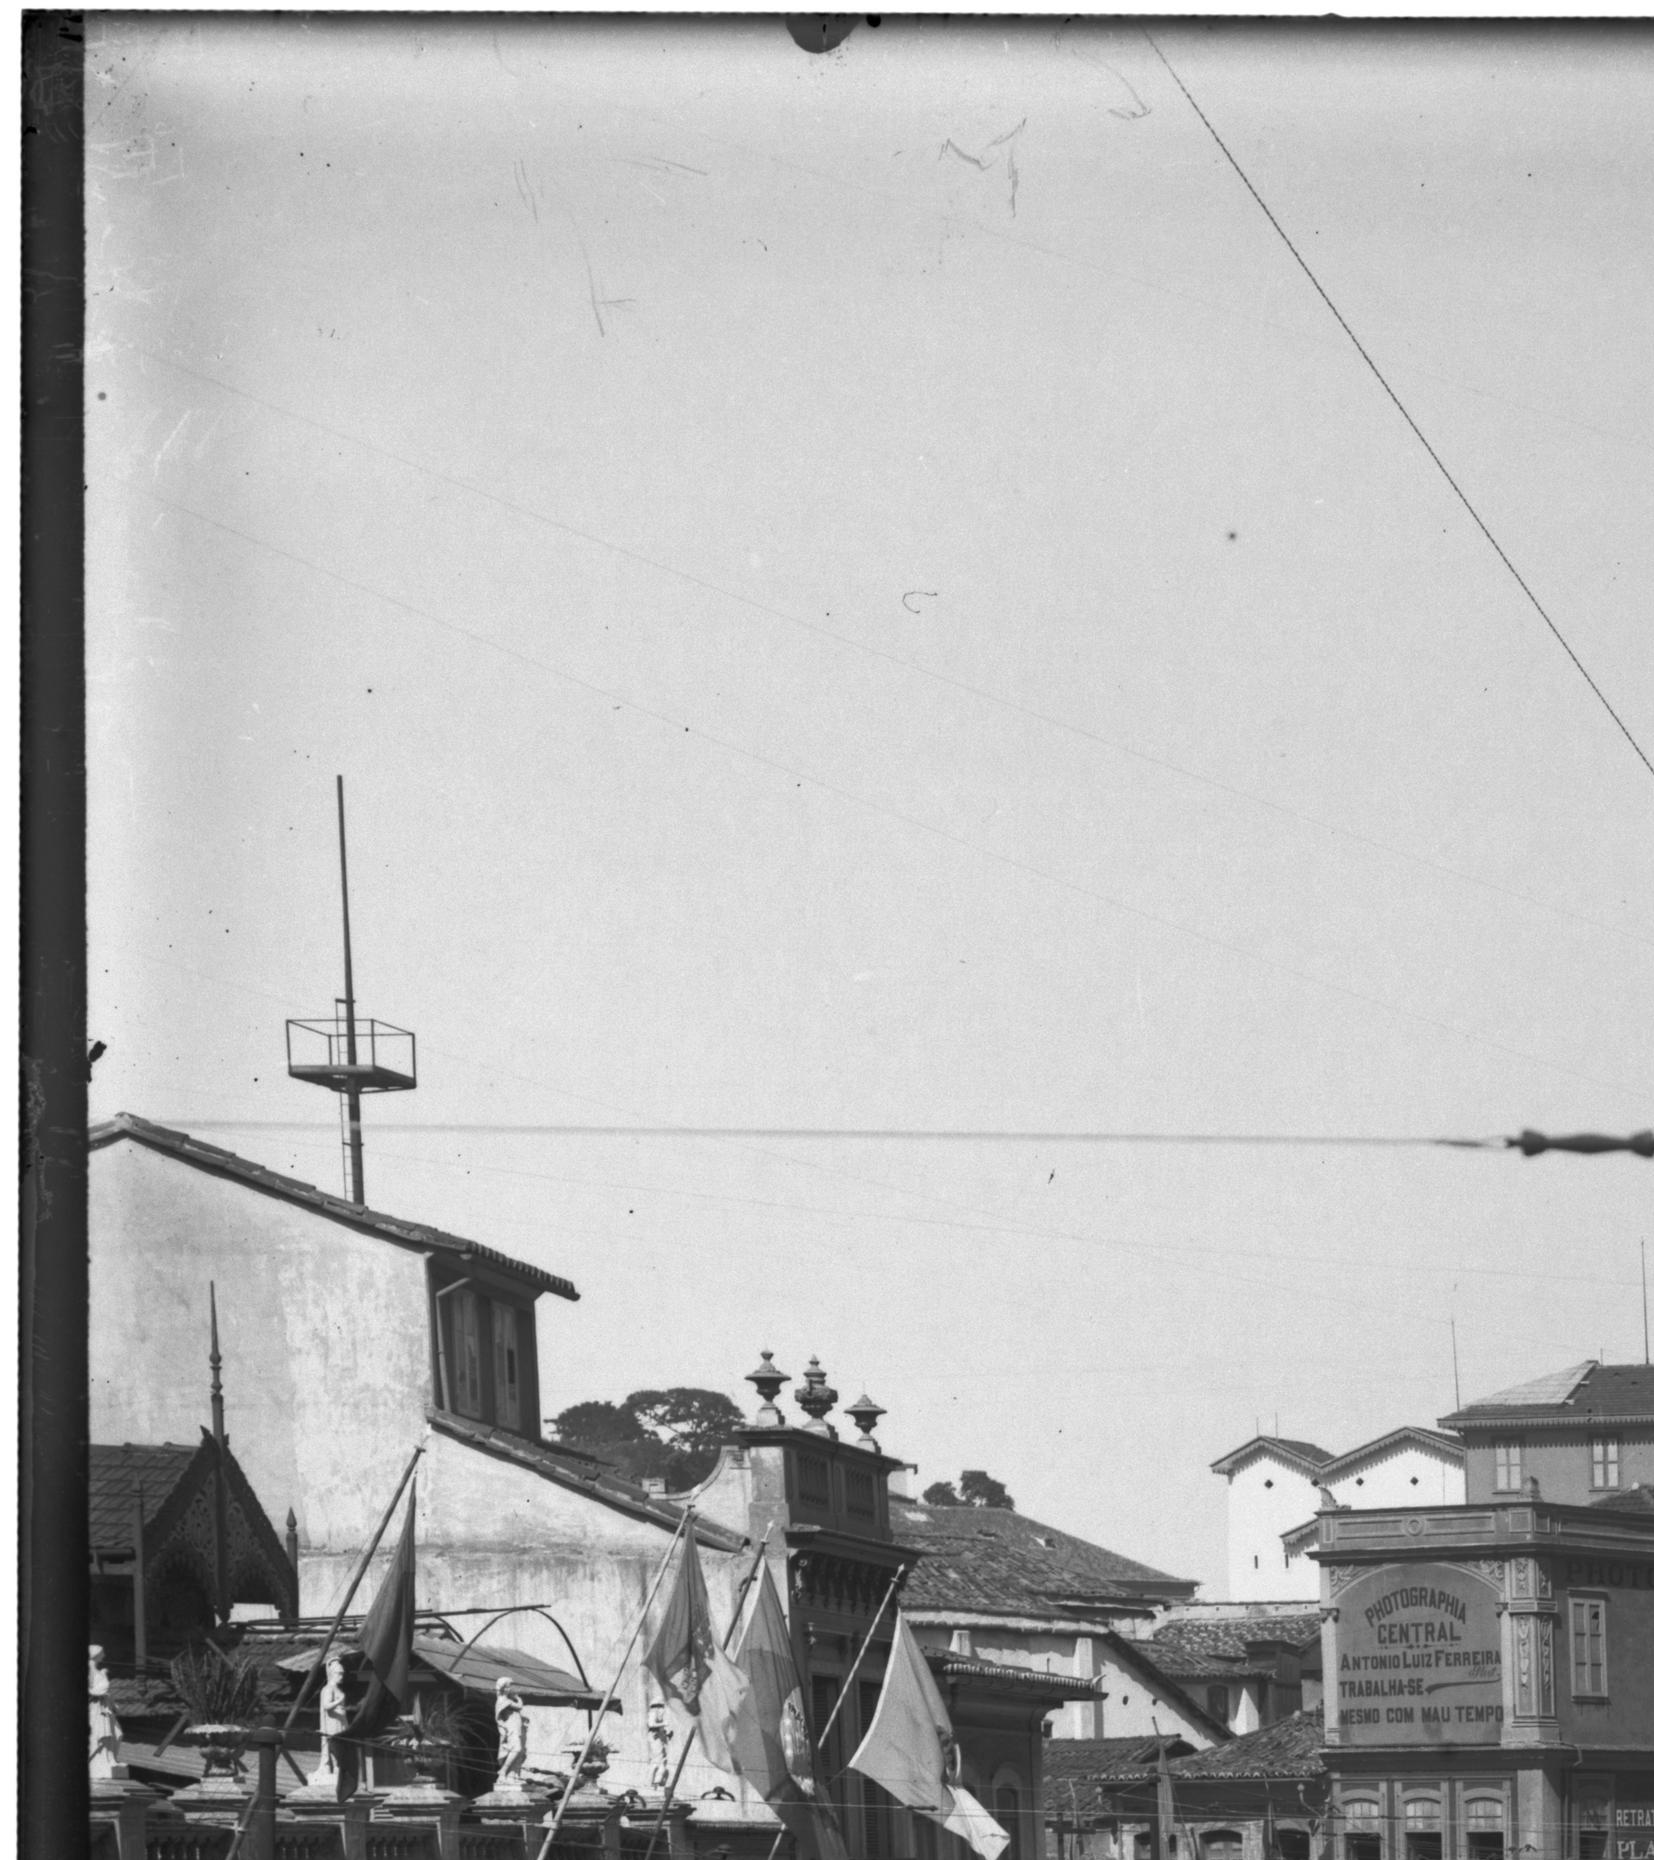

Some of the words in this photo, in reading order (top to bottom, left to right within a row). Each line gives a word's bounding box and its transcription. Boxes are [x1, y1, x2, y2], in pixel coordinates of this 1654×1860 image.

[1364, 1586, 1466, 1628] PHOTOGRAPHIA
[1377, 1621, 1462, 1644] CENTRAL
[1341, 1653, 1400, 1671] ANTONIO
[1402, 1651, 1433, 1669] LUIZ
[1435, 1650, 1502, 1668] FERREIRA
[1340, 1678, 1425, 1698] TRABALHA-SE
[1340, 1708, 1380, 1725] MESMO
[1386, 1707, 1414, 1723] COM
[1421, 1706, 1451, 1723] MAU
[1454, 1705, 1503, 1723] TEMPO
